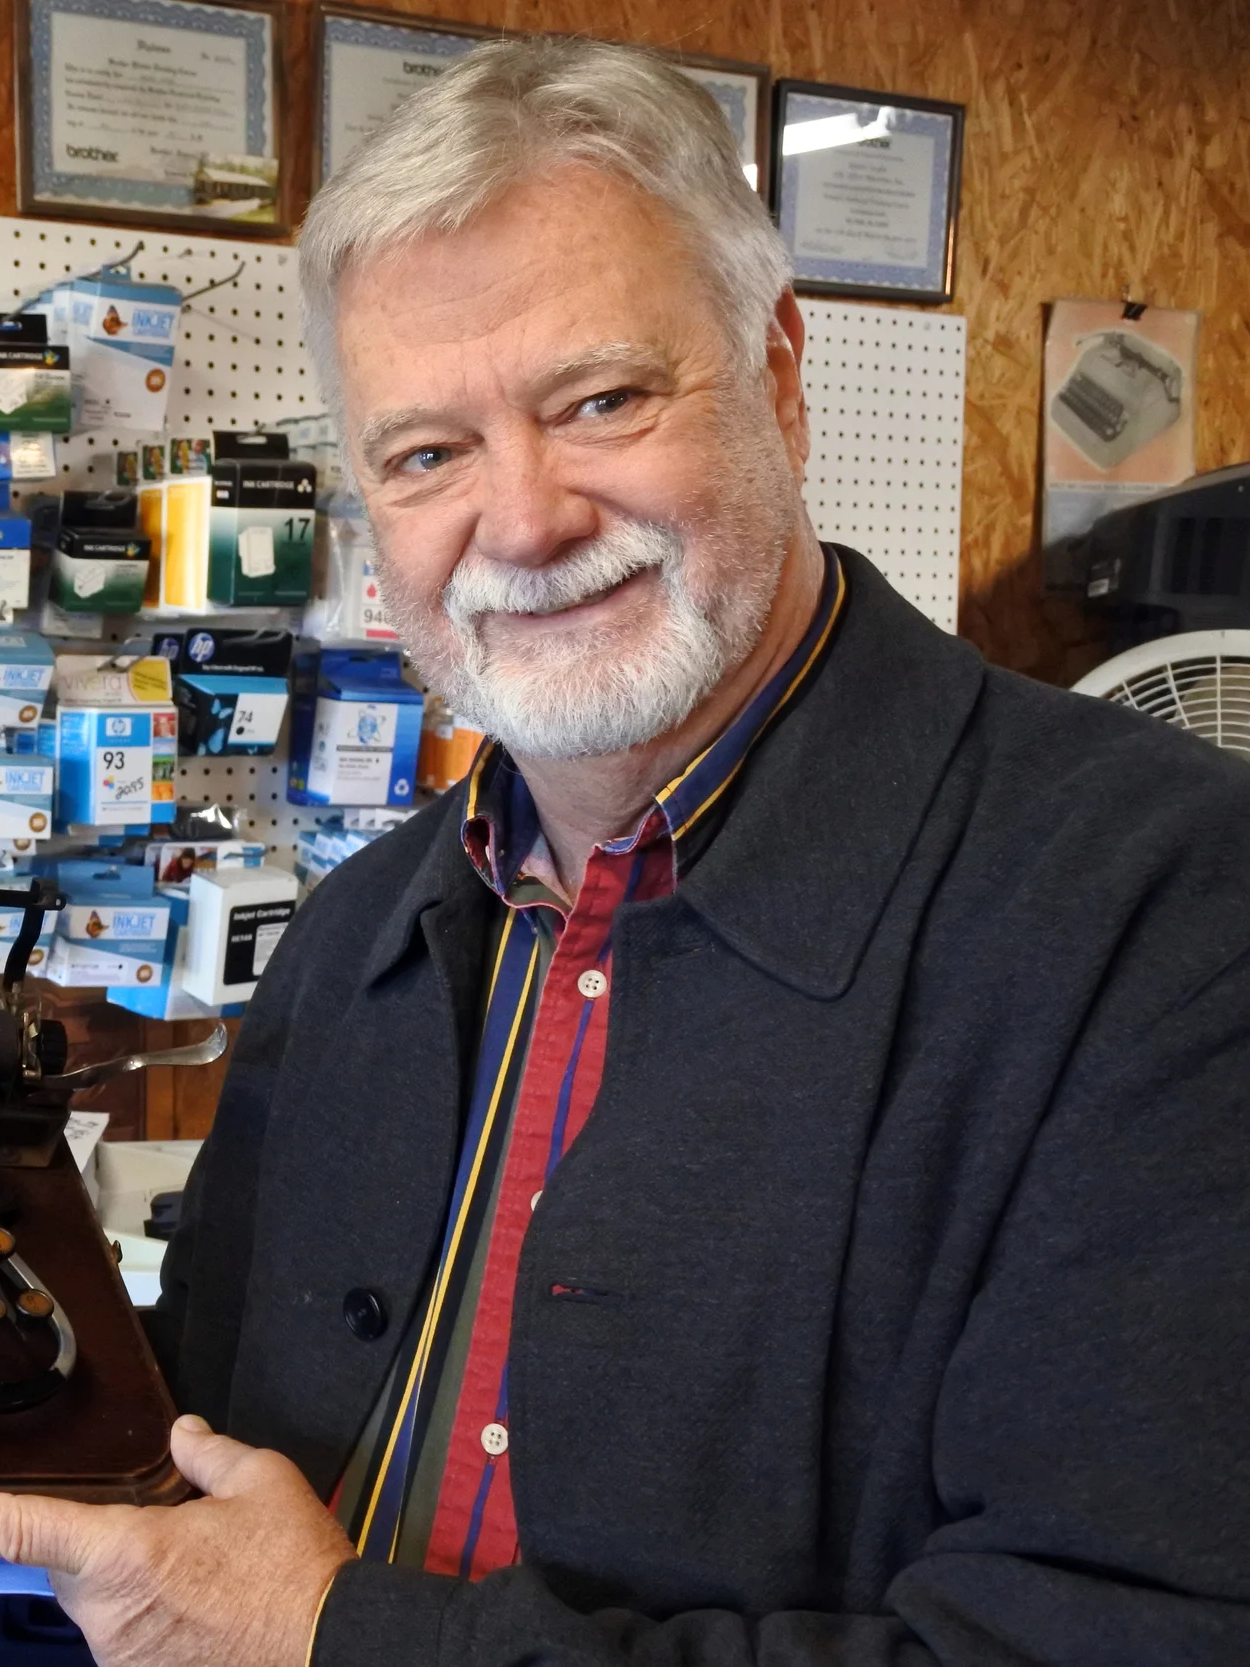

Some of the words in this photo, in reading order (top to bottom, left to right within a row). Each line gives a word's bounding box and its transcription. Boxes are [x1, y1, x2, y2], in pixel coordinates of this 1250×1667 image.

[66, 144, 118, 163] brother
[284, 518, 310, 541] 17
[190, 632, 214, 662] hp
[103, 751, 125, 770] 93
[256, 908, 291, 919] Cartridge
